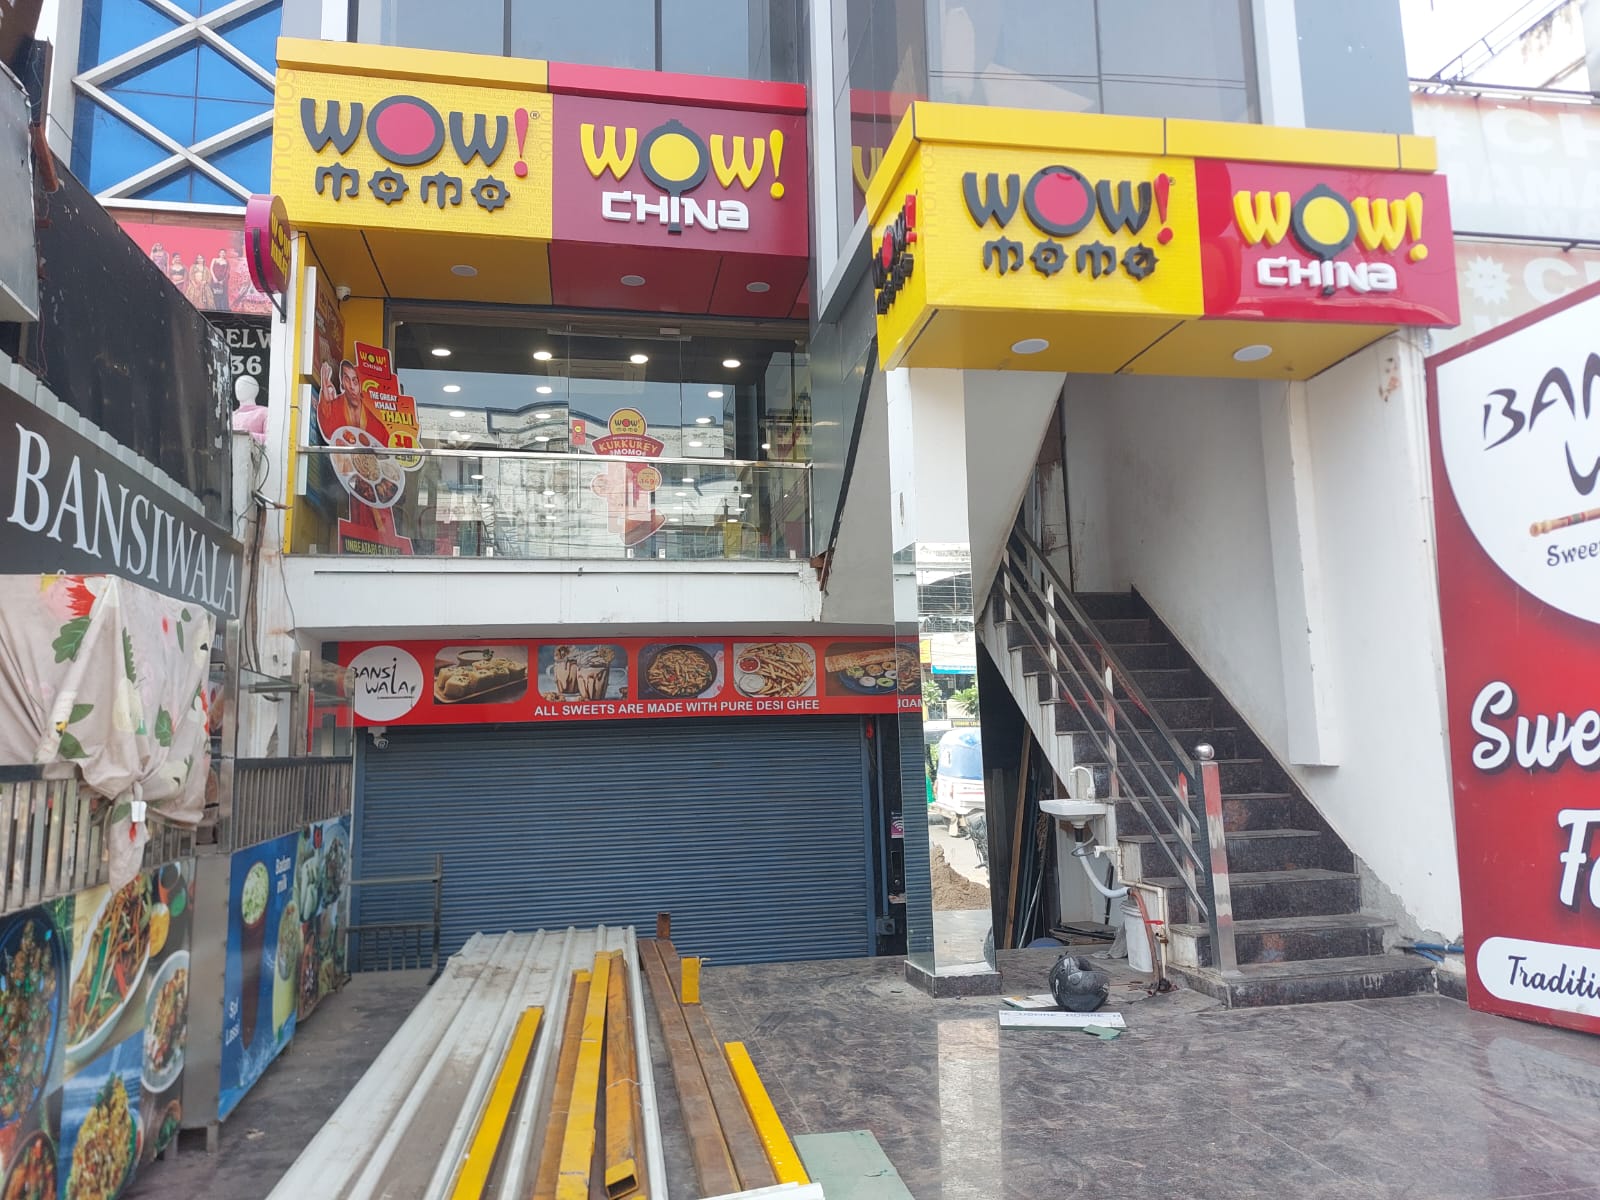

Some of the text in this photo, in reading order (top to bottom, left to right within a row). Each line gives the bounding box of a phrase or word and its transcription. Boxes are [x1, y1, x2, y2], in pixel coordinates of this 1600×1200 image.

[300, 95, 529, 178] WOW!
[580, 119, 785, 200] WOW!
[962, 164, 1174, 245] WOW!
[1233, 183, 1428, 262] WOW!
[369, 390, 398, 403] THE GREAT
[374, 401, 397, 411] KHALI
[381, 410, 414, 426] THALI
[614, 418, 640, 428] WOW!
[598, 439, 658, 453] KURKUREY
[614, 448, 642, 456] MOMO
[7, 422, 237, 616] BANSIWALA
[1547, 541, 1600, 567] Swee
[534, 699, 820, 716] ALL SWEETS ARE MADE WITH PURE DESI GHEE
[1508, 955, 1600, 1000] Traditi
